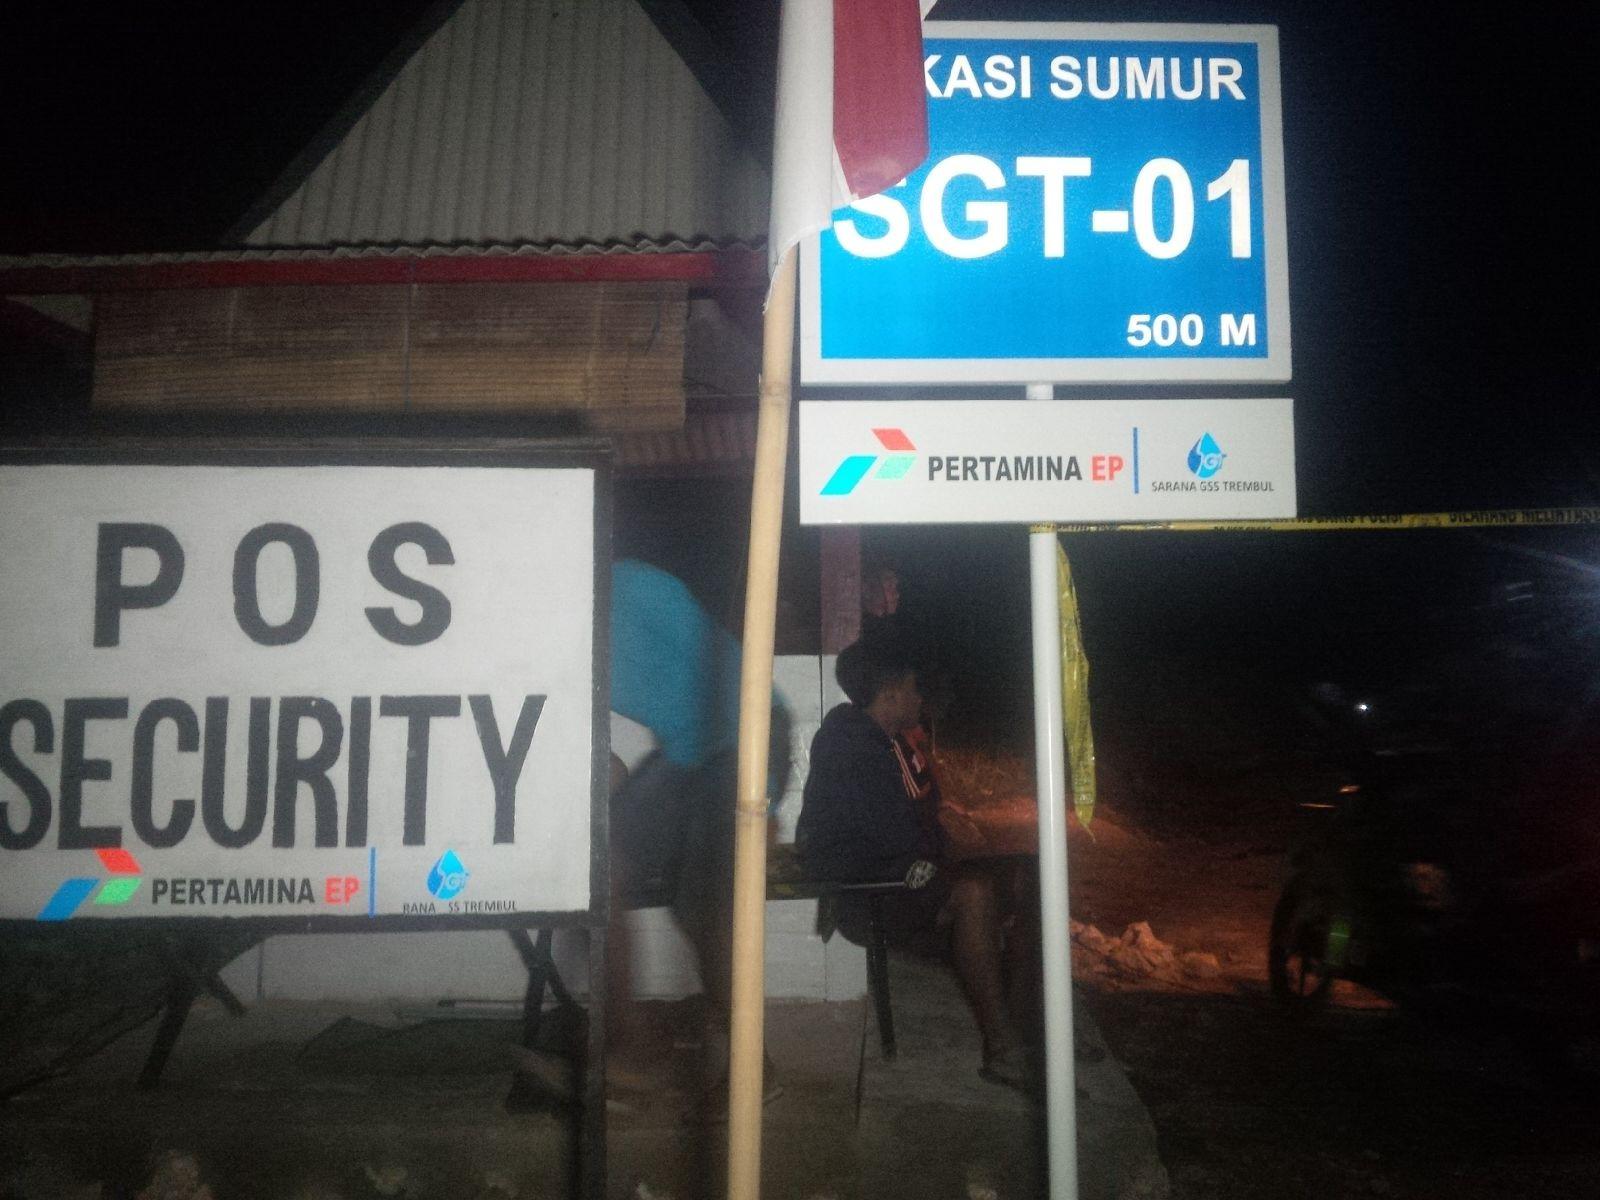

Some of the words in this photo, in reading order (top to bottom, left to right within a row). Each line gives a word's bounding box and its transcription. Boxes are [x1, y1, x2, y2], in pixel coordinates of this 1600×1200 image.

[1050, 56, 1246, 101] SUMUR
[834, 155, 1253, 260] SGT-01
[1126, 313, 1204, 347] 500
[1220, 314, 1256, 347] M
[929, 455, 1082, 482] PERTAMINA
[1091, 455, 1123, 481] EP
[1151, 481, 1197, 492] SARANA
[1200, 481, 1220, 492] GSS
[1223, 481, 1275, 492] TREMBUL
[94, 520, 455, 647] POS
[0, 695, 547, 850] SECURITY
[152, 877, 314, 905] PERTAMINA
[325, 877, 360, 904] EP
